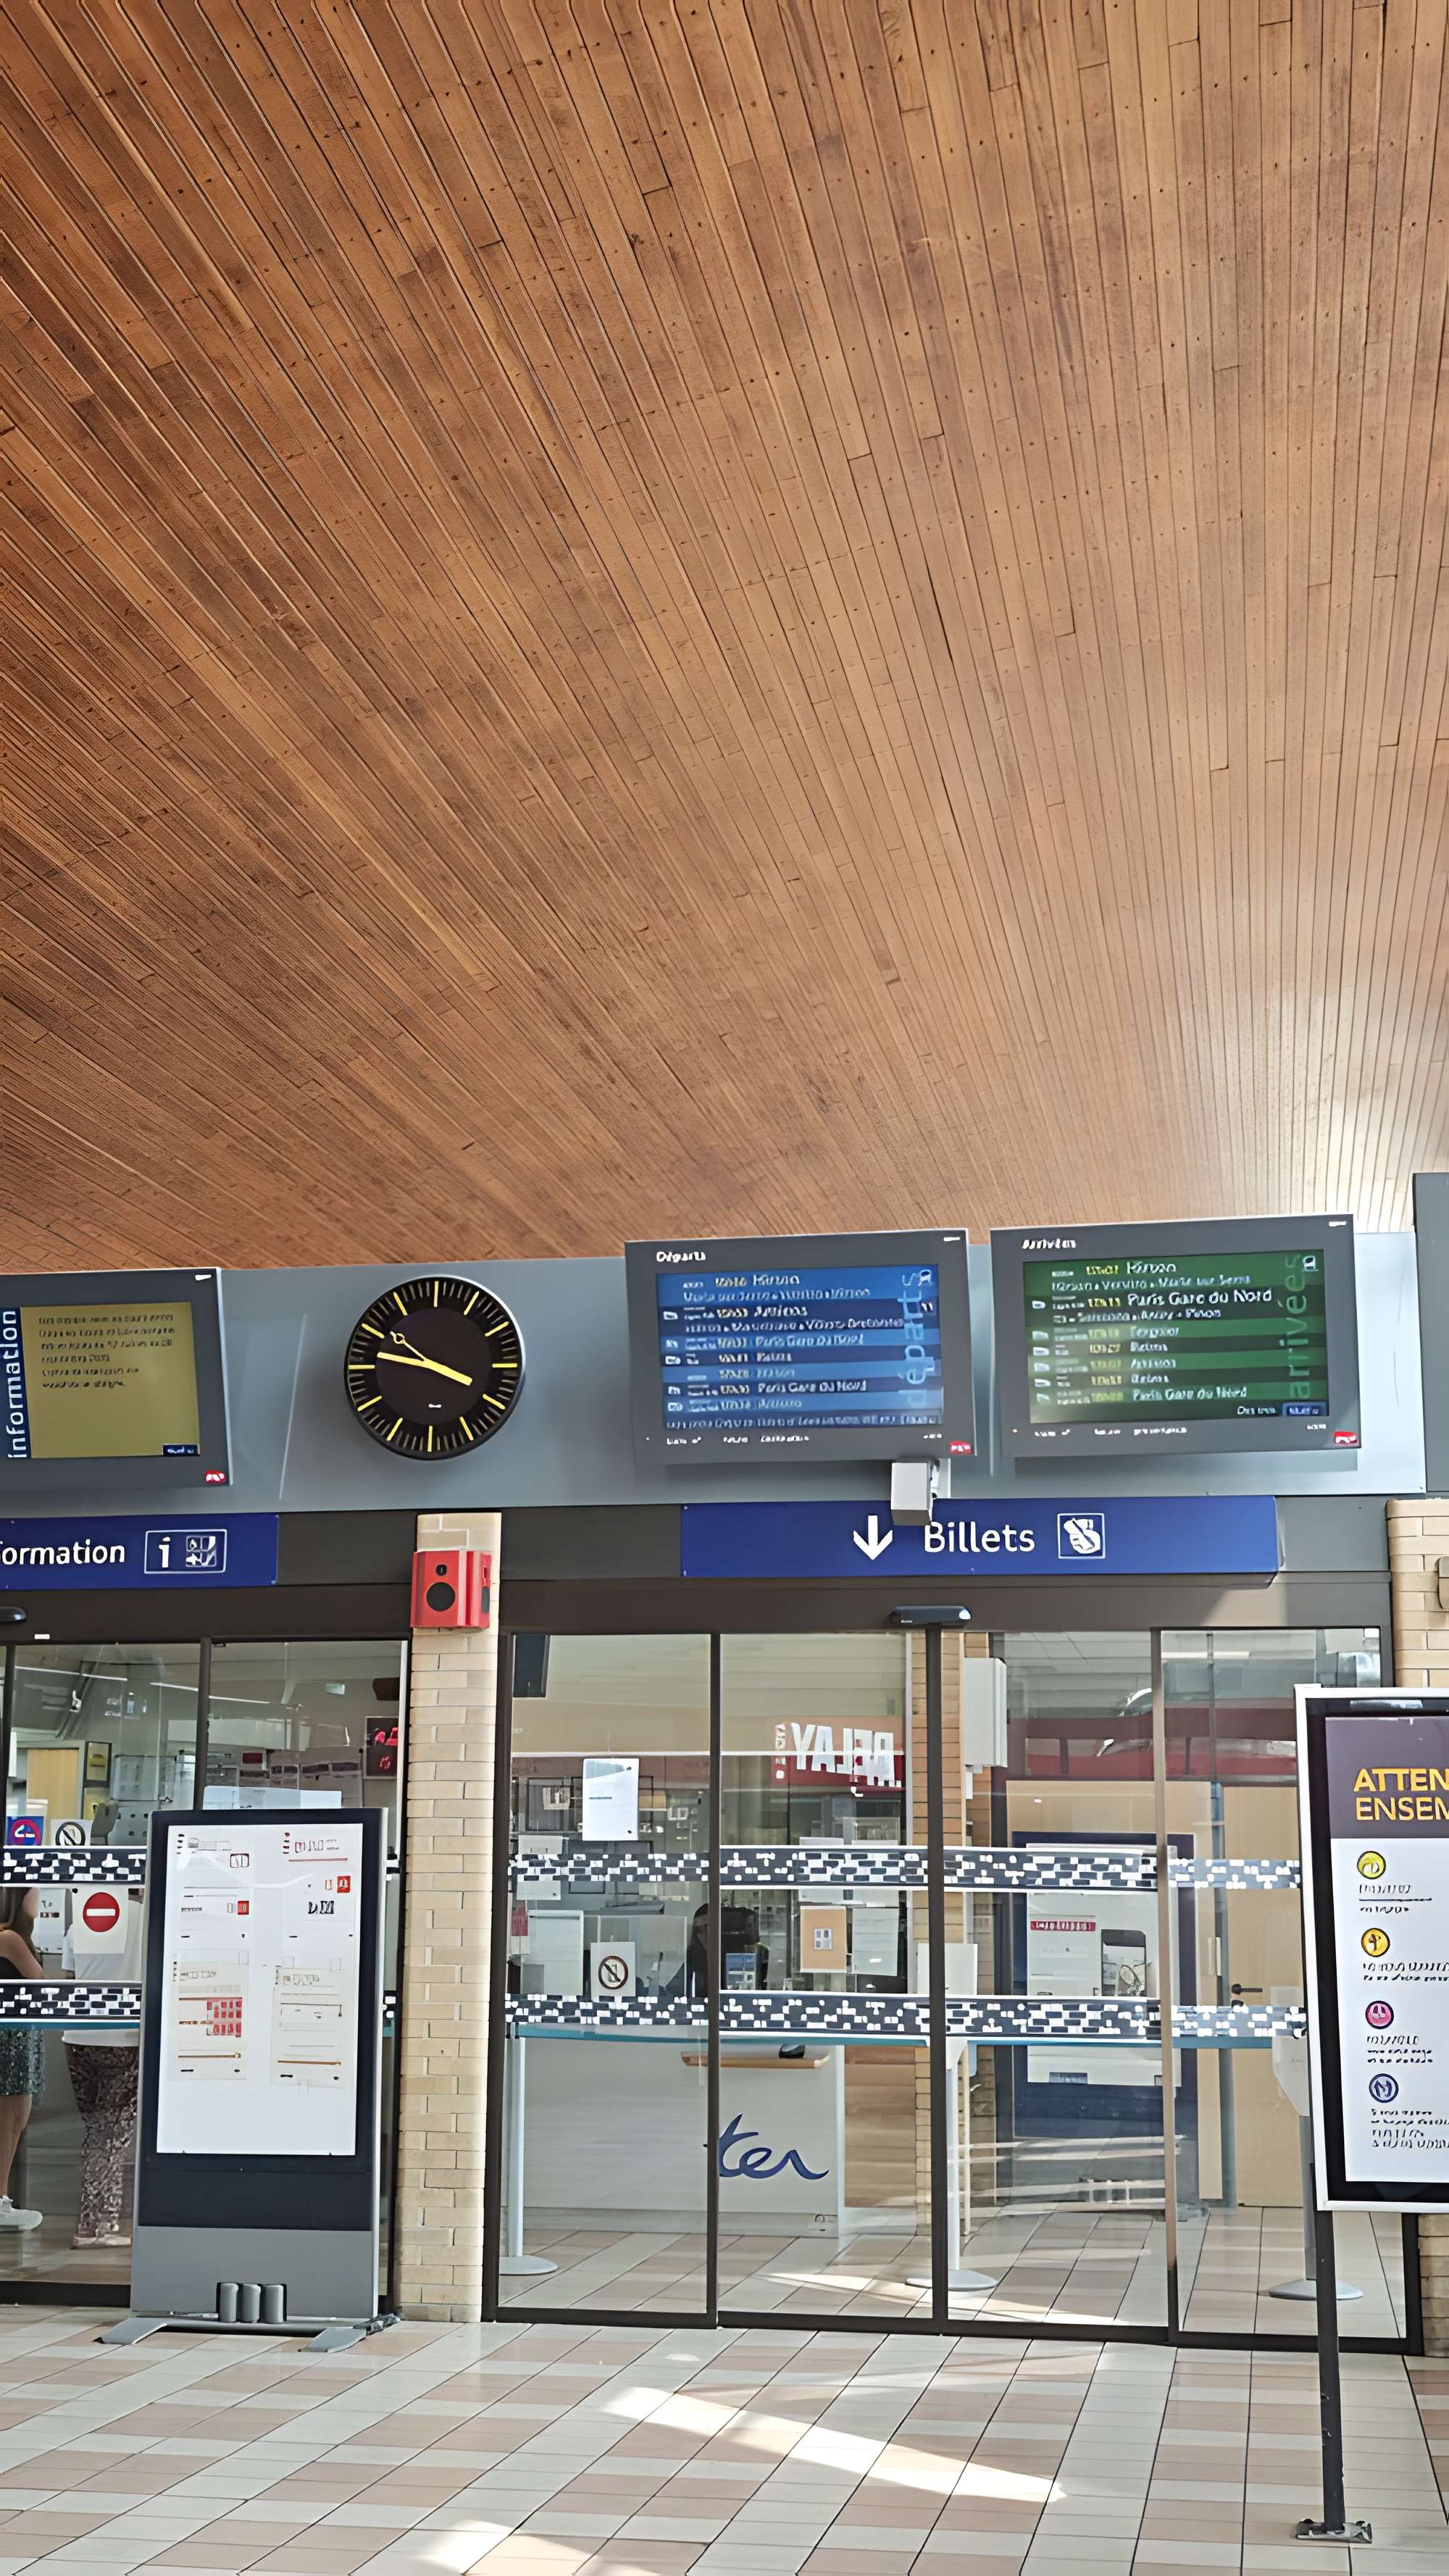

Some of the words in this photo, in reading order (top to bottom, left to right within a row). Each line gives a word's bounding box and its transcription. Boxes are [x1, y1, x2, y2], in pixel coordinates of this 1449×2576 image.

[0, 1310, 28, 1459] information
[924, 1521, 1035, 1552] Billets
[0, 1539, 125, 1565] ormation
[1353, 1768, 1449, 1792] ATTEN
